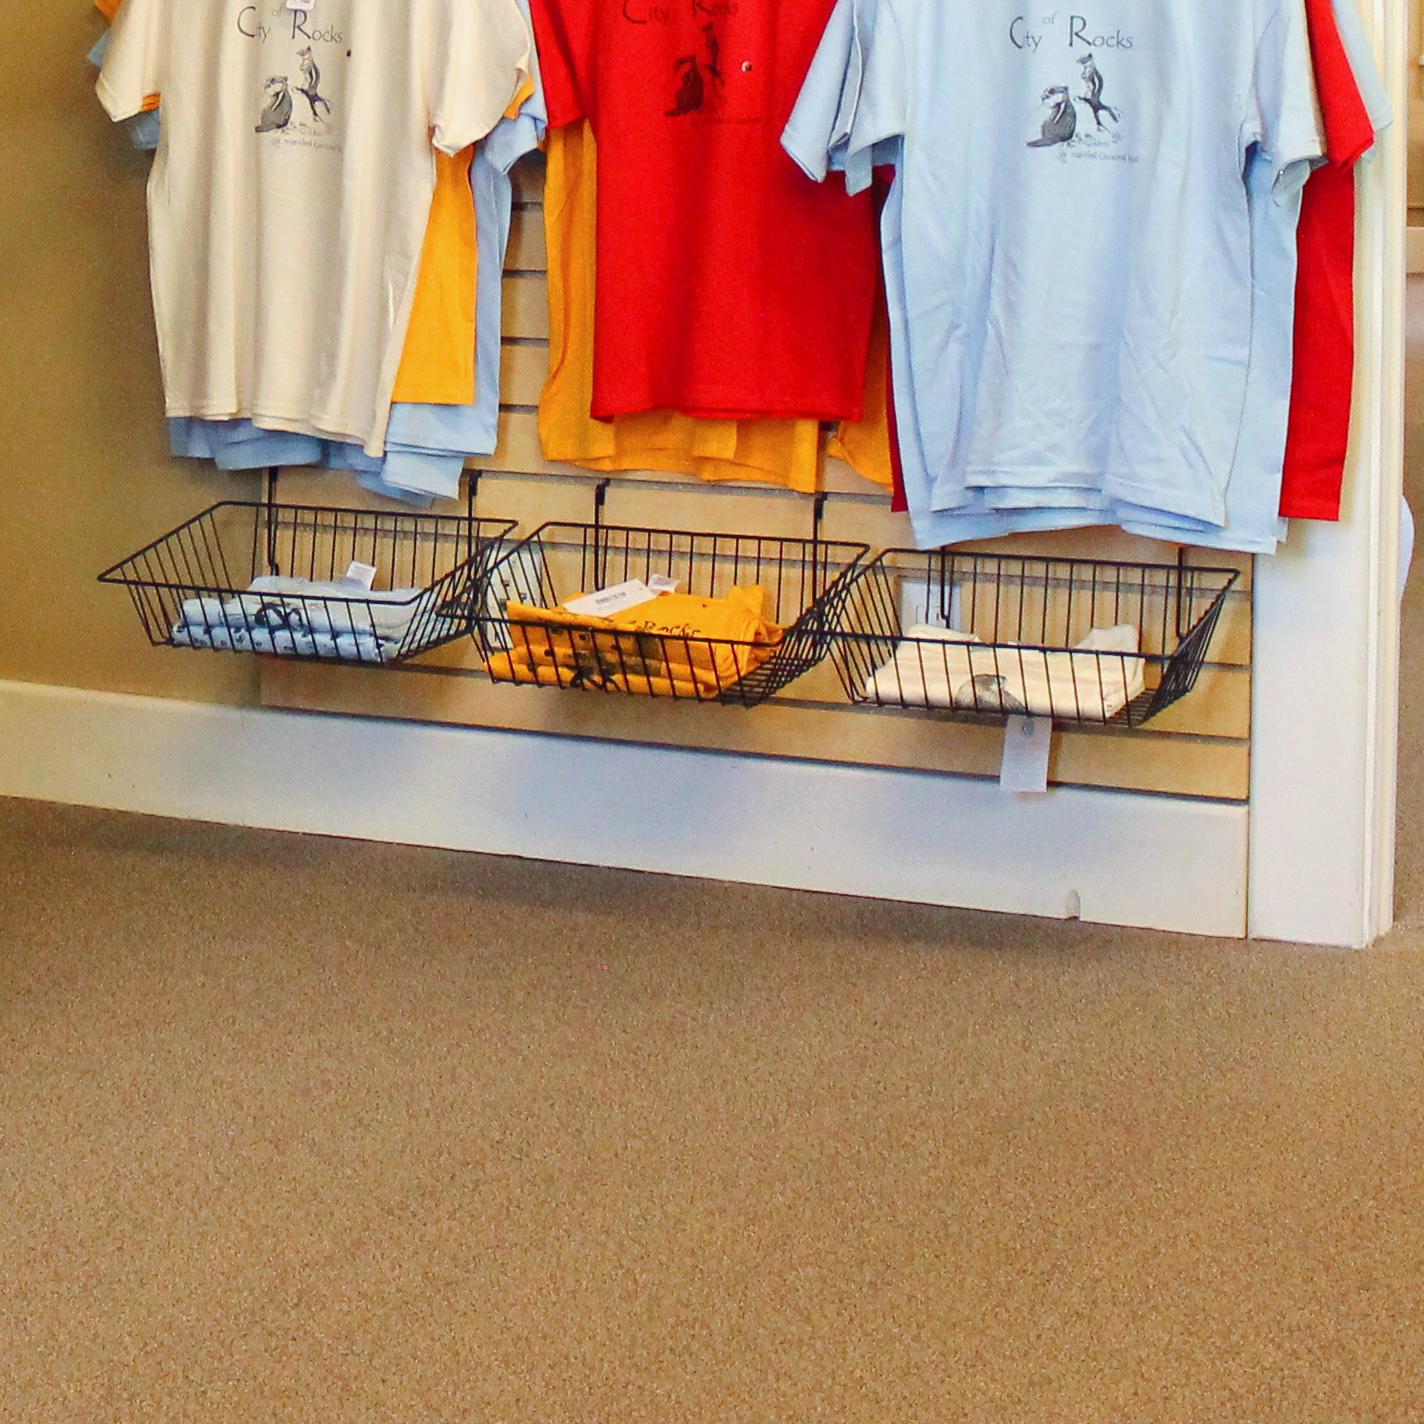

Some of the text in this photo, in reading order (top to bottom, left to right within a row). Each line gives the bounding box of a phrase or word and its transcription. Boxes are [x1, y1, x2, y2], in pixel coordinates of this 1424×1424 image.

[291, 8, 345, 44] Rocks
[1010, 10, 1134, 53] City of Rocks
